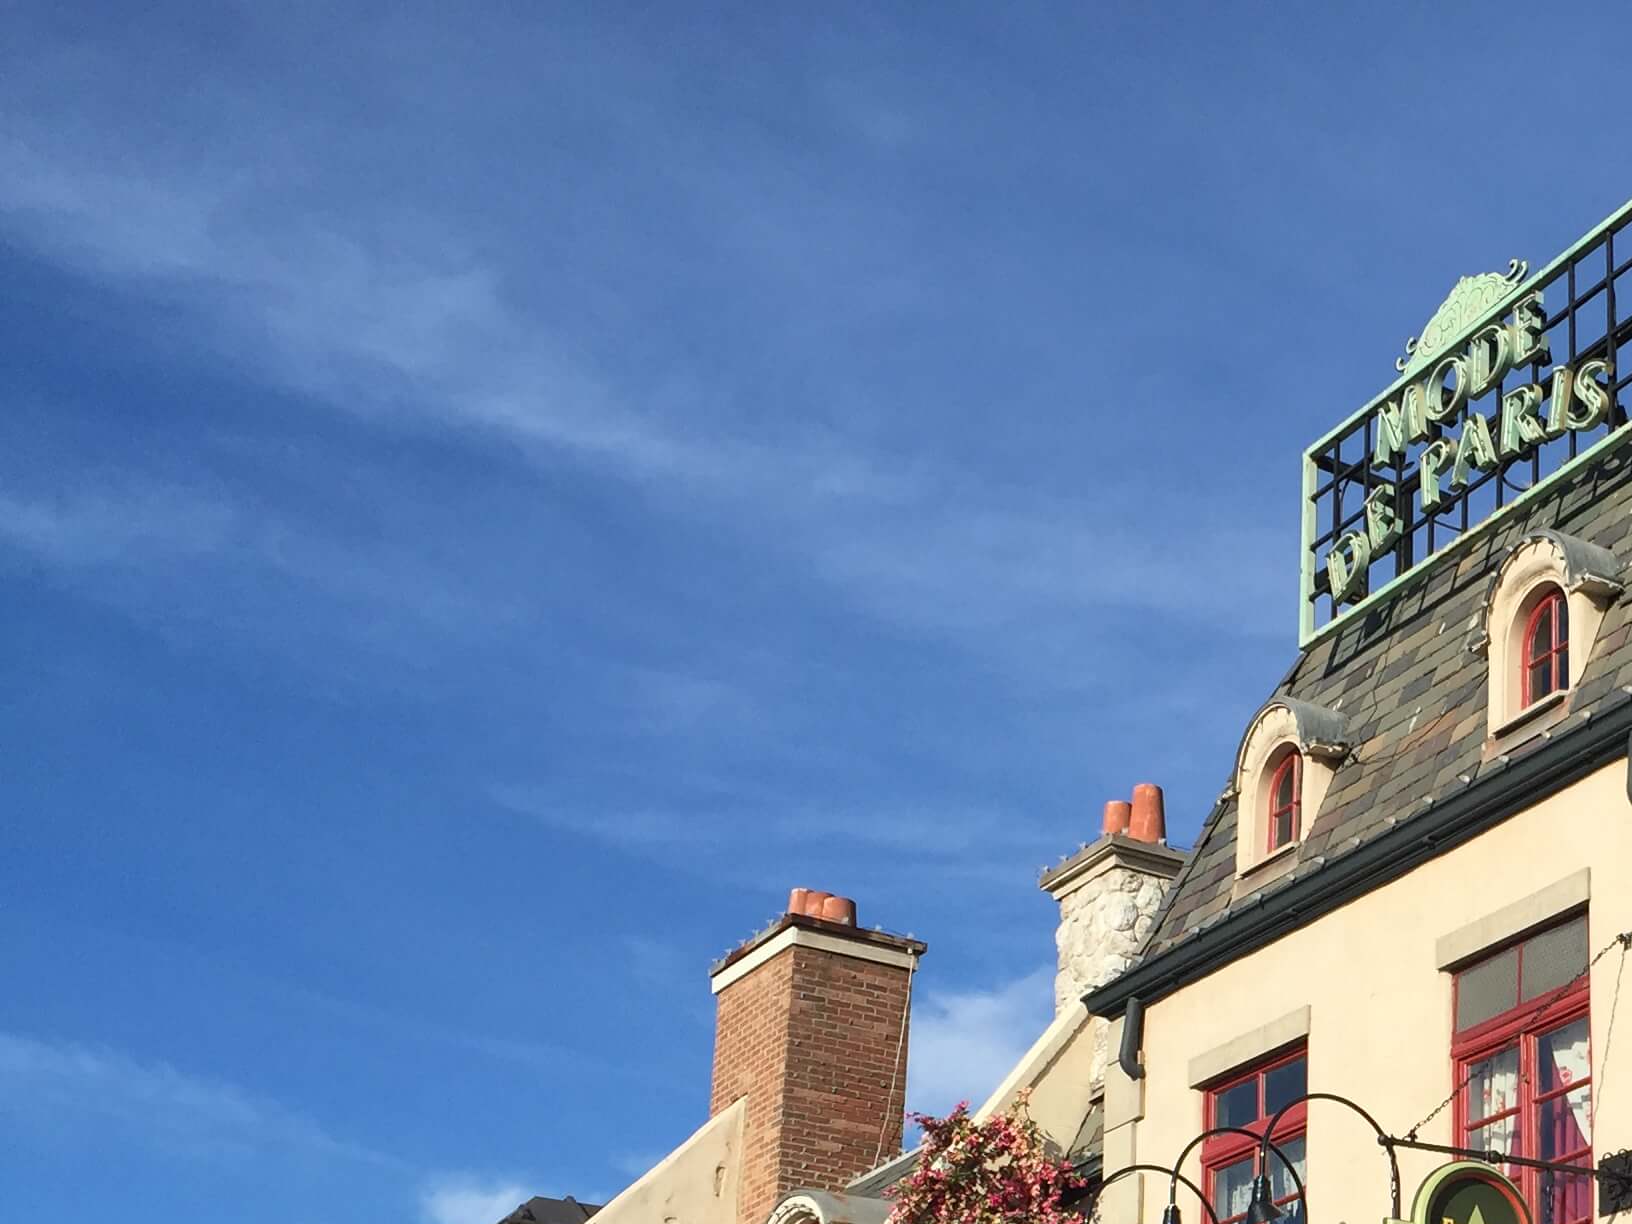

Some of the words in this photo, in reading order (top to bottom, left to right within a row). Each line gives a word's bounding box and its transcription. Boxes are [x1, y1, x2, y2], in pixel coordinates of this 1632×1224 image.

[1327, 484, 1403, 602] DE
[1420, 360, 1615, 513] PARIS
[1374, 290, 1550, 470] MODE
